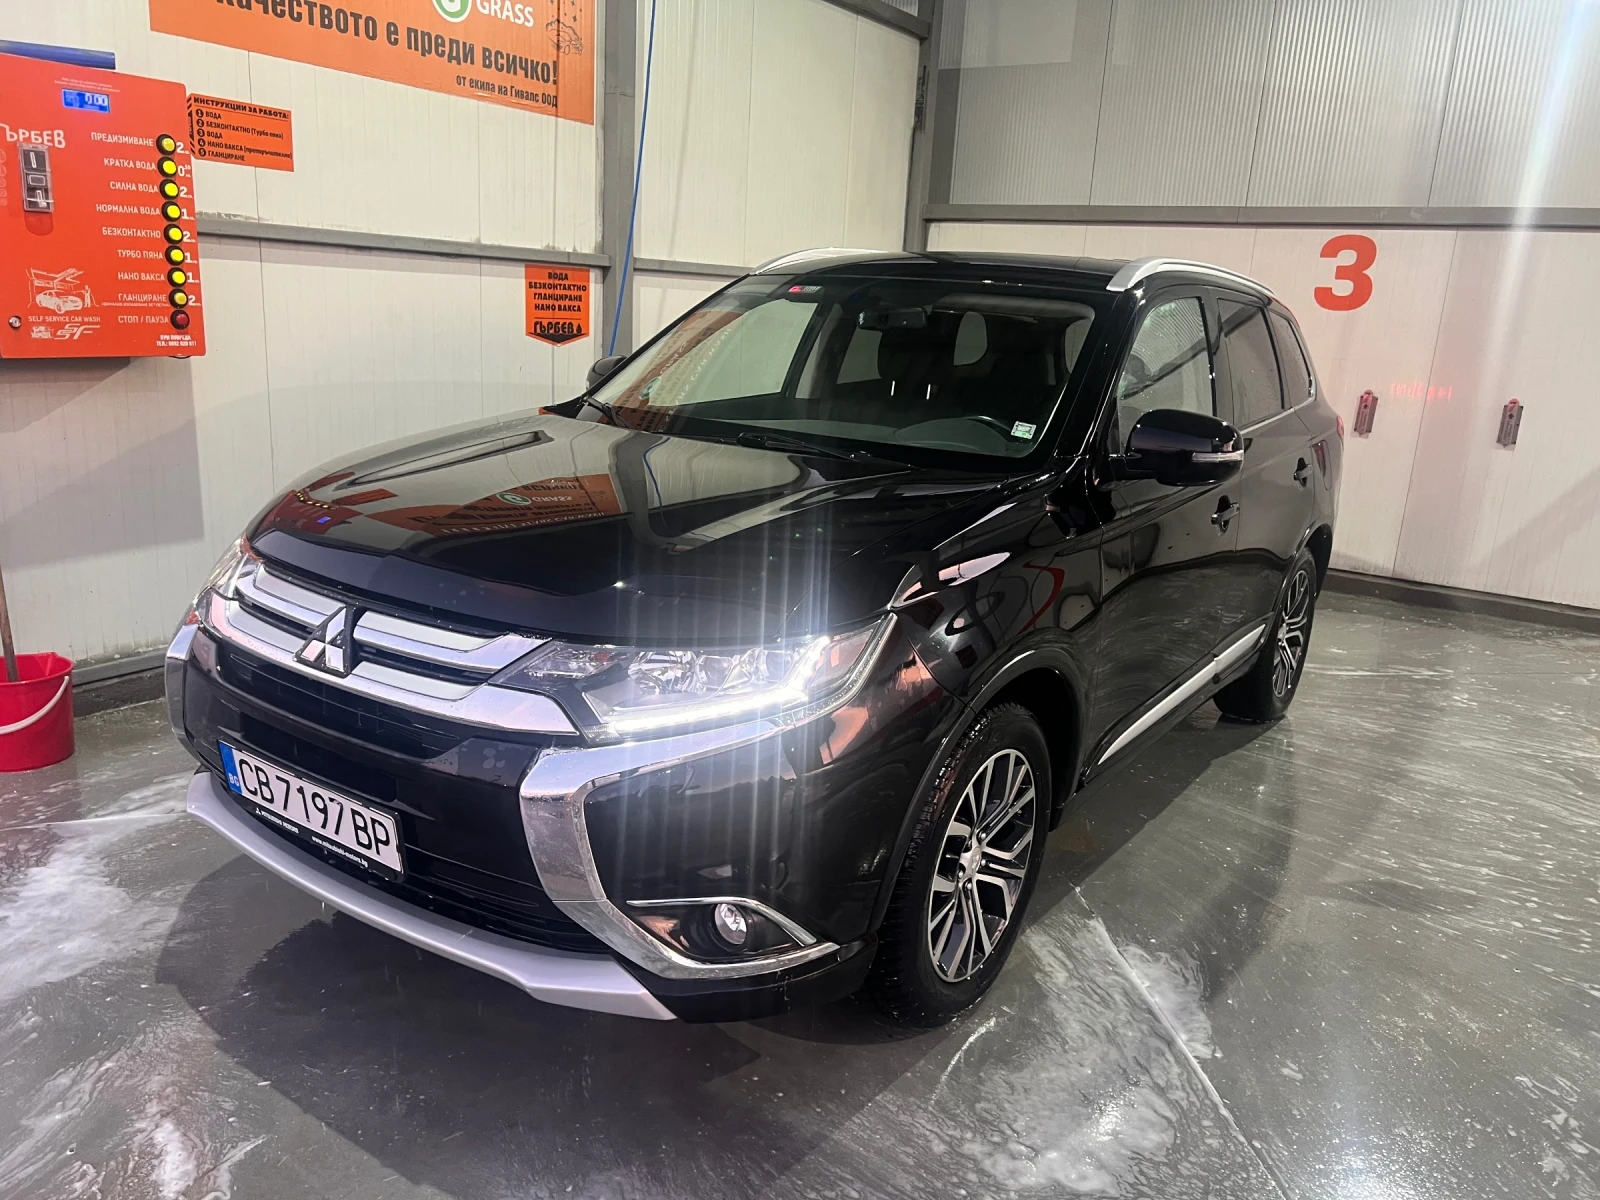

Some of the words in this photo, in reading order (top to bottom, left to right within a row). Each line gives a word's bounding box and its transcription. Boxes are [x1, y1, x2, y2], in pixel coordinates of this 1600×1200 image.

[476, 0, 534, 27] GRASS
[216, 0, 378, 40] чеството
[386, 22, 399, 46] е
[406, 26, 475, 66] преди
[482, 46, 558, 85] всичко!
[456, 75, 466, 86] от
[469, 78, 495, 93] екипа
[498, 85, 508, 96] на
[194, 96, 247, 111] ИНСТРУКЦИИ
[259, 109, 290, 119] РАБОТА:
[206, 111, 222, 119] ВОДА
[206, 121, 250, 133] БЕЗКОНТАКТНО
[206, 130, 222, 139] ВОДА
[91, 132, 154, 146] ПРЕДИЗМИВАНЕ
[176, 142, 184, 153] 2
[224, 143, 243, 151] ВАКСА
[208, 150, 245, 161] ГЛАНЦИРАНЕ
[104, 158, 134, 168] КРАТКА
[136, 161, 156, 170] ВОДА
[110, 181, 136, 191] СИЛНА
[138, 184, 158, 193] ВОДА
[180, 186, 187, 198] 2
[96, 204, 138, 214] НОРМАЛНА
[140, 206, 160, 215] ВОДА
[181, 208, 189, 219] 1
[102, 227, 160, 238] БЕЗКОНТАКТНО
[182, 231, 191, 242] 2
[117, 249, 141, 258] ТУРБО
[143, 251, 163, 259] ПЯНА
[184, 252, 192, 263] 1
[118, 272, 139, 280] НАНО
[141, 273, 165, 281] ВАКСА
[187, 272, 194, 283] 1
[548, 272, 568, 280] ВОДА
[1314, 234, 1378, 312] 3
[528, 282, 587, 292] БЕЗКОНТАКТНО
[118, 293, 167, 302] ГЛАНЦИРАНЕ
[188, 295, 196, 306] 2
[534, 293, 582, 302] ГЛАНЦИРАНЕ
[228, 772, 240, 786] BG
